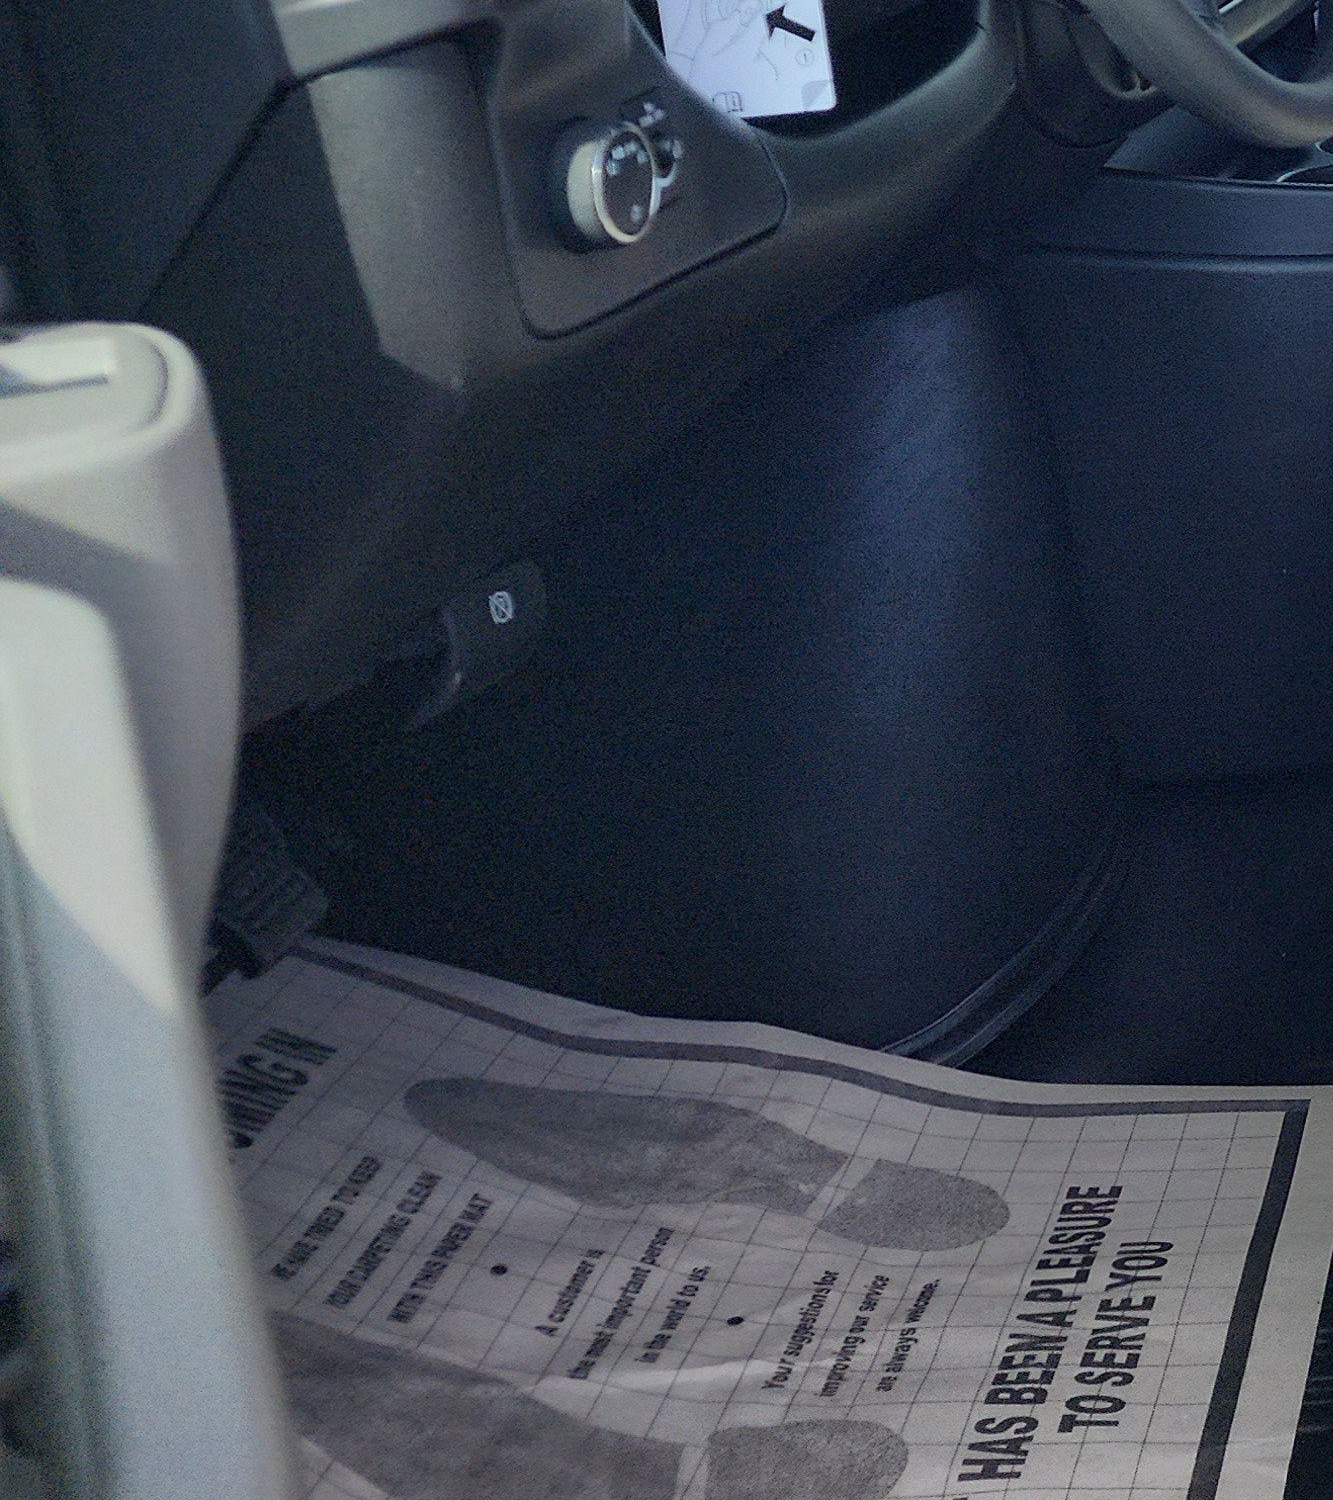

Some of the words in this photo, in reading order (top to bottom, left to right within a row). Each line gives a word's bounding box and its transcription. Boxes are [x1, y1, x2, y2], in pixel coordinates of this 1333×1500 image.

[253, 1027, 339, 1066] IN
[303, 1205, 345, 1241] TRIED
[331, 1185, 360, 1205] TO
[350, 1156, 384, 1185] KEEP
[323, 1278, 362, 1310] YOUR
[347, 1212, 412, 1282] CARPETING
[396, 1170, 443, 1216] CLEAN
[410, 1259, 448, 1291] THIS
[431, 1221, 477, 1260] PAPER
[458, 1193, 493, 1224] MAT
[640, 1227, 675, 1267] person
[1023, 1185, 1124, 1303] PLEASURE
[688, 1266, 711, 1282] us.
[1105, 1241, 1174, 1292] YOU
[534, 1325, 559, 1337] A
[548, 1259, 596, 1323] customer
[581, 1249, 605, 1259] is
[596, 1266, 651, 1330] important
[677, 1284, 699, 1297] to
[859, 1274, 890, 1312] service
[905, 1279, 942, 1325] welcome.
[660, 1298, 691, 1331] world
[761, 1358, 795, 1389] Your
[783, 1287, 832, 1357] suggestions
[813, 1270, 840, 1287] for
[850, 1315, 870, 1334] our
[1016, 1309, 1078, 1328] A
[584, 1330, 614, 1358] most
[634, 1352, 660, 1363] in
[642, 1333, 673, 1349] the
[885, 1327, 918, 1374] always
[1074, 1295, 1156, 1388] SERVE
[567, 1359, 596, 1380] the
[814, 1336, 865, 1397] improving
[876, 1375, 898, 1393] are
[984, 1333, 1069, 1405] BEEN
[1057, 1395, 1126, 1434] TO
[957, 1416, 1039, 1482] HAS
